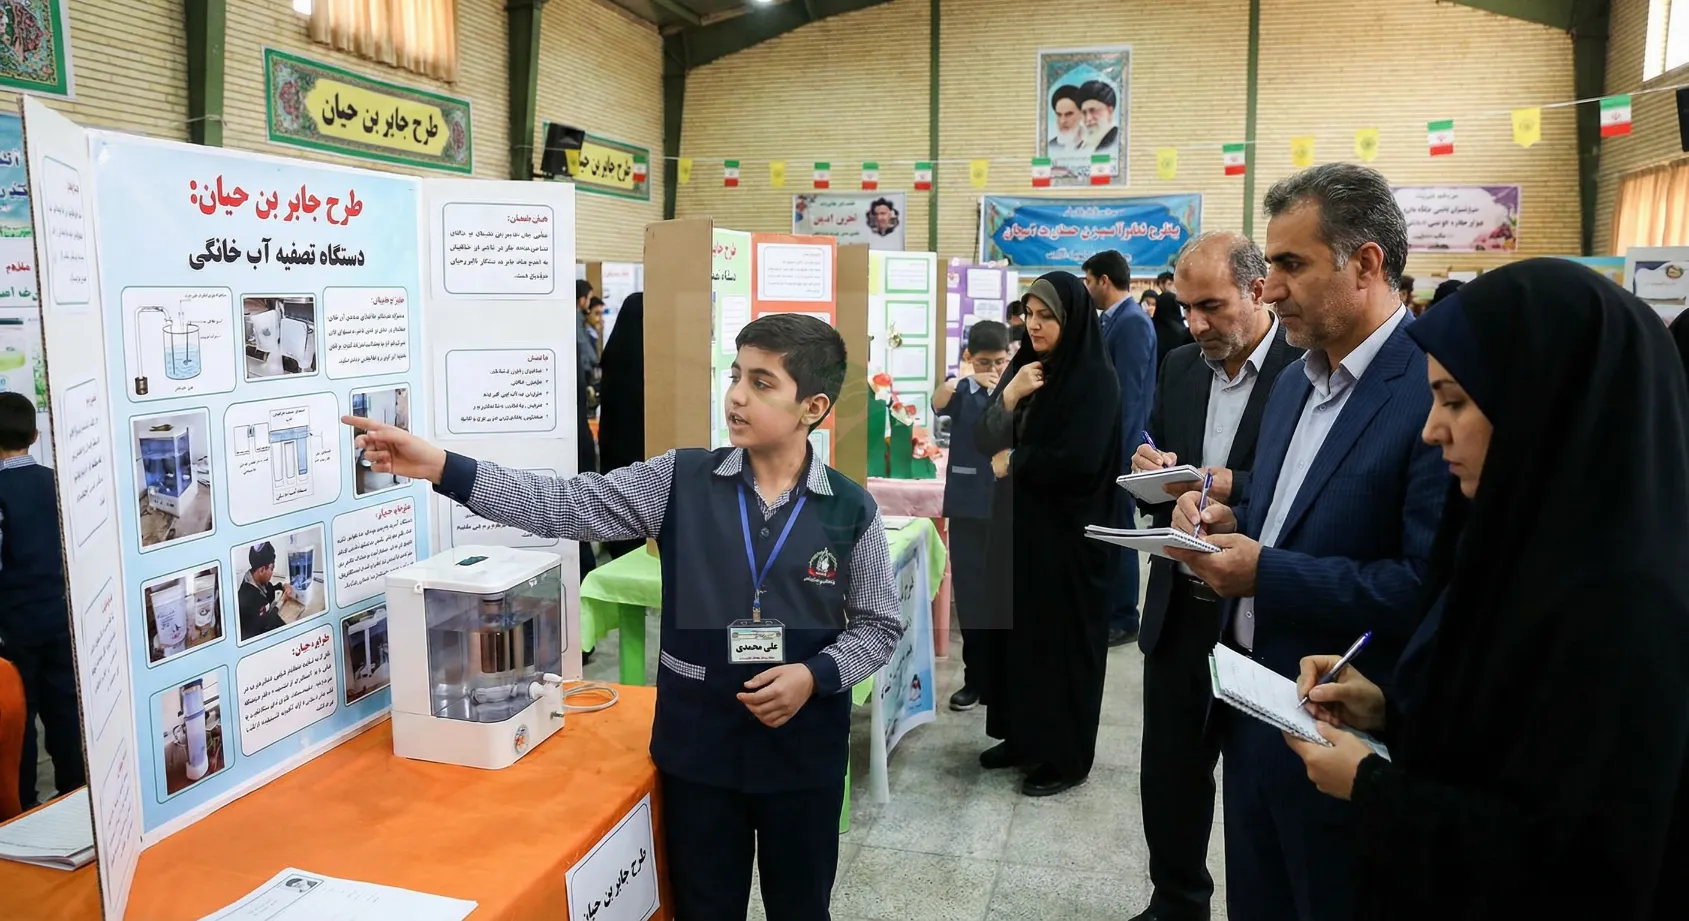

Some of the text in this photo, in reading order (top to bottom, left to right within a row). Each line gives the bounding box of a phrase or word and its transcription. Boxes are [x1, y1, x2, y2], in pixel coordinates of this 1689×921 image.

[322, 92, 438, 145] طرح جابر بن حیان
[591, 158, 601, 177] بن
[617, 159, 631, 182] طرح
[189, 174, 363, 226] طرح جابر بن حیان:
[188, 237, 365, 270] دستگاه تصفیه آب خانگی
[735, 642, 779, 654] علی محمدی
[630, 847, 646, 878] طرح
[604, 886, 613, 908] بن
[614, 868, 629, 897] جابر
